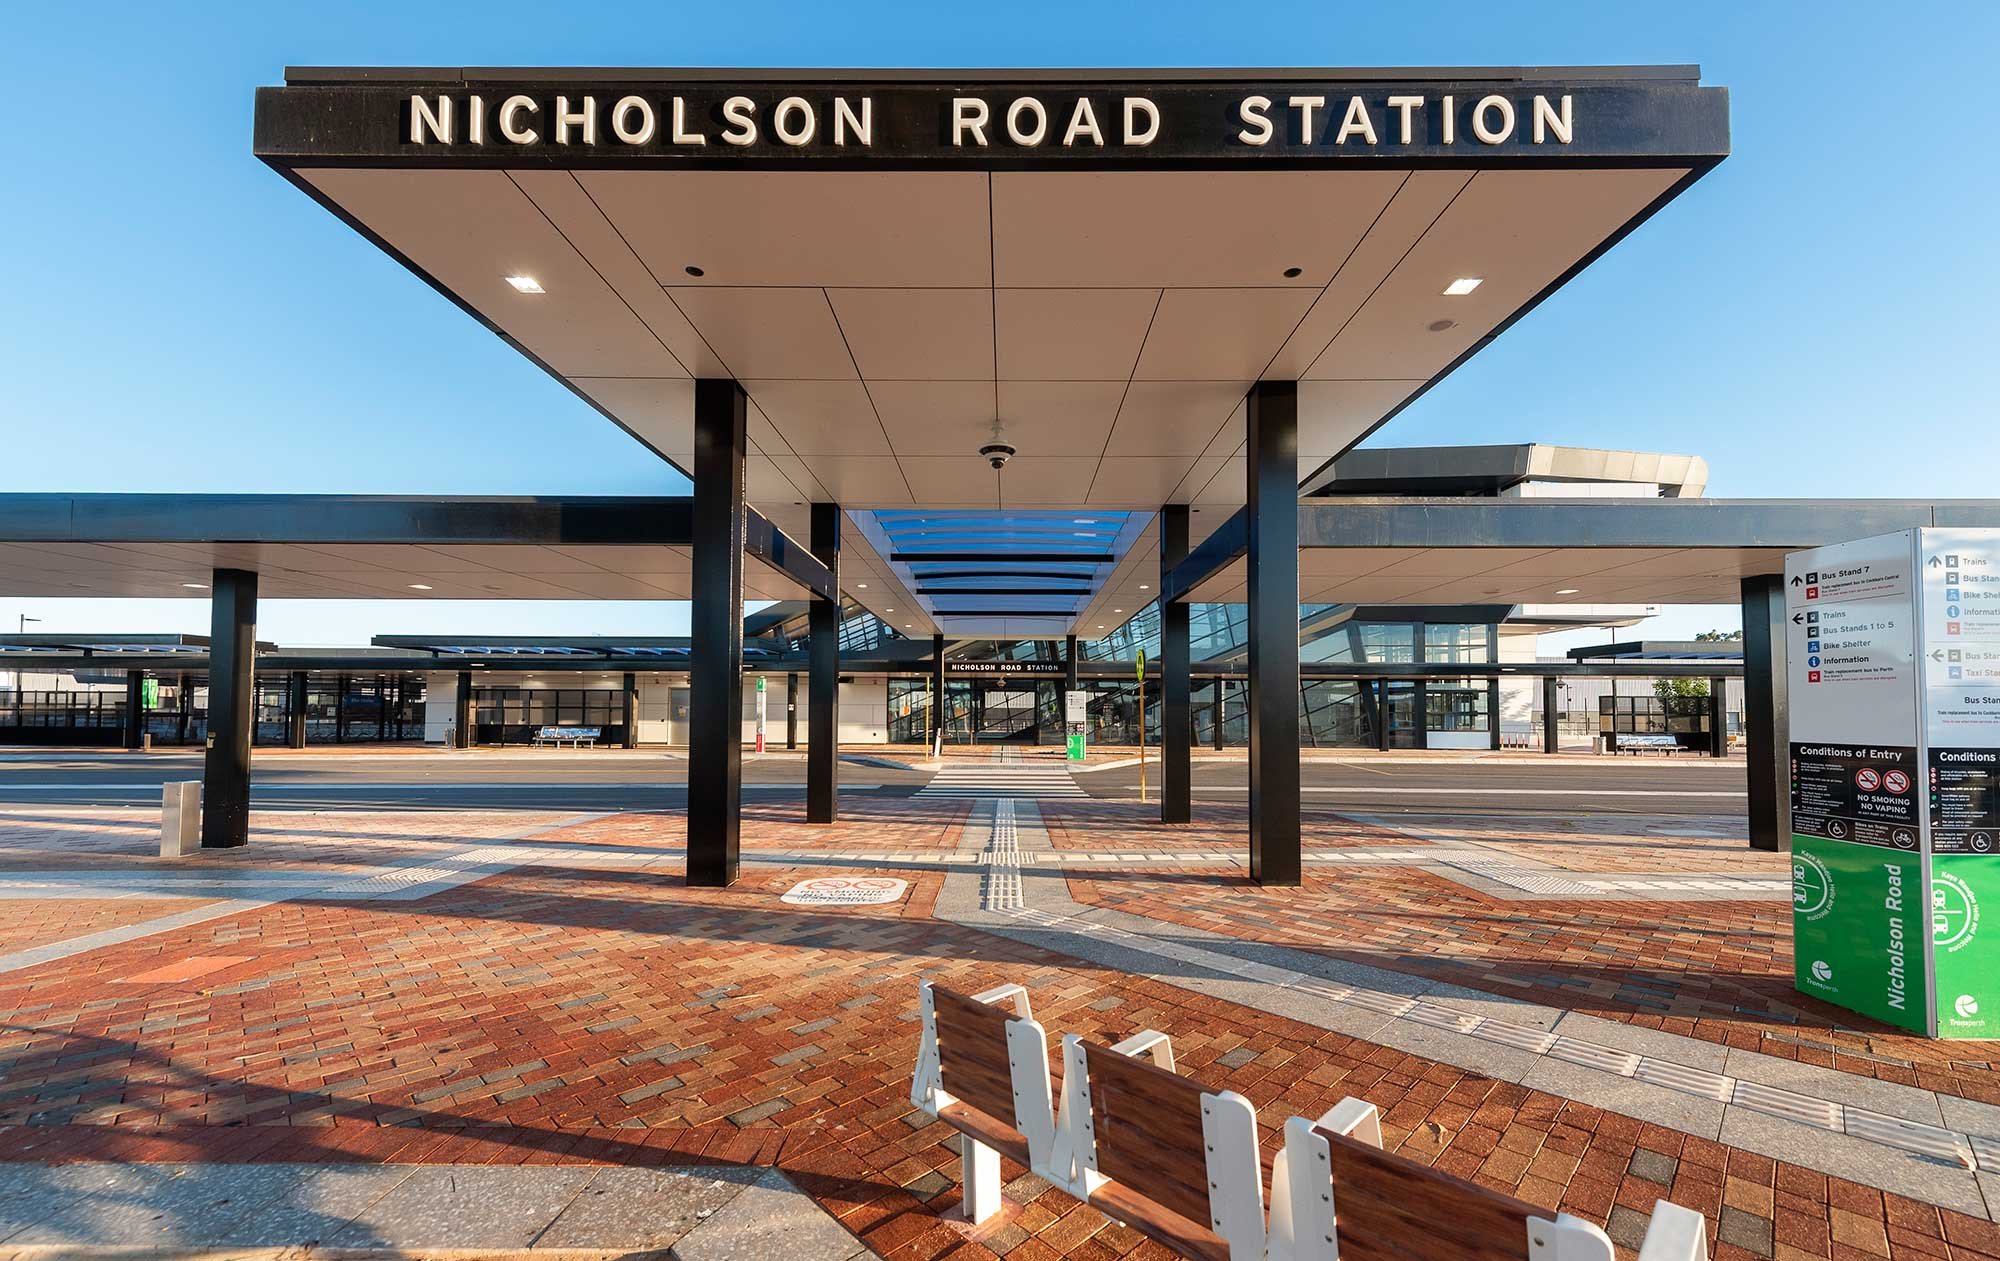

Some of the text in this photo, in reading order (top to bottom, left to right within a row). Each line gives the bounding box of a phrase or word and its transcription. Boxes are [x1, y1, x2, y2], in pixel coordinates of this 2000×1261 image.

[410, 94, 1574, 147] NICHOLSON ROAD STATION
[1962, 558, 1987, 566] Trains
[1822, 572, 1836, 580] Bus
[1838, 568, 1862, 578] Stand
[1822, 611, 1846, 620] Trains
[1840, 623, 1868, 632] Stands
[1824, 640, 1872, 650] Bike Shelter
[1824, 656, 1869, 664] Information
[1800, 746, 1902, 761] Conditions of Entry
[1940, 752, 1996, 762] Conditions
[1871, 796, 1910, 806] SMOKING
[1875, 804, 1907, 814] VAPING
[1800, 849, 1816, 861] Kaya
[1941, 871, 1959, 883] Kaya
[1884, 864, 1906, 1011] Nicholson Road
[1806, 977, 1839, 993] Transperth
[1950, 1018, 1985, 1028] Transperth
